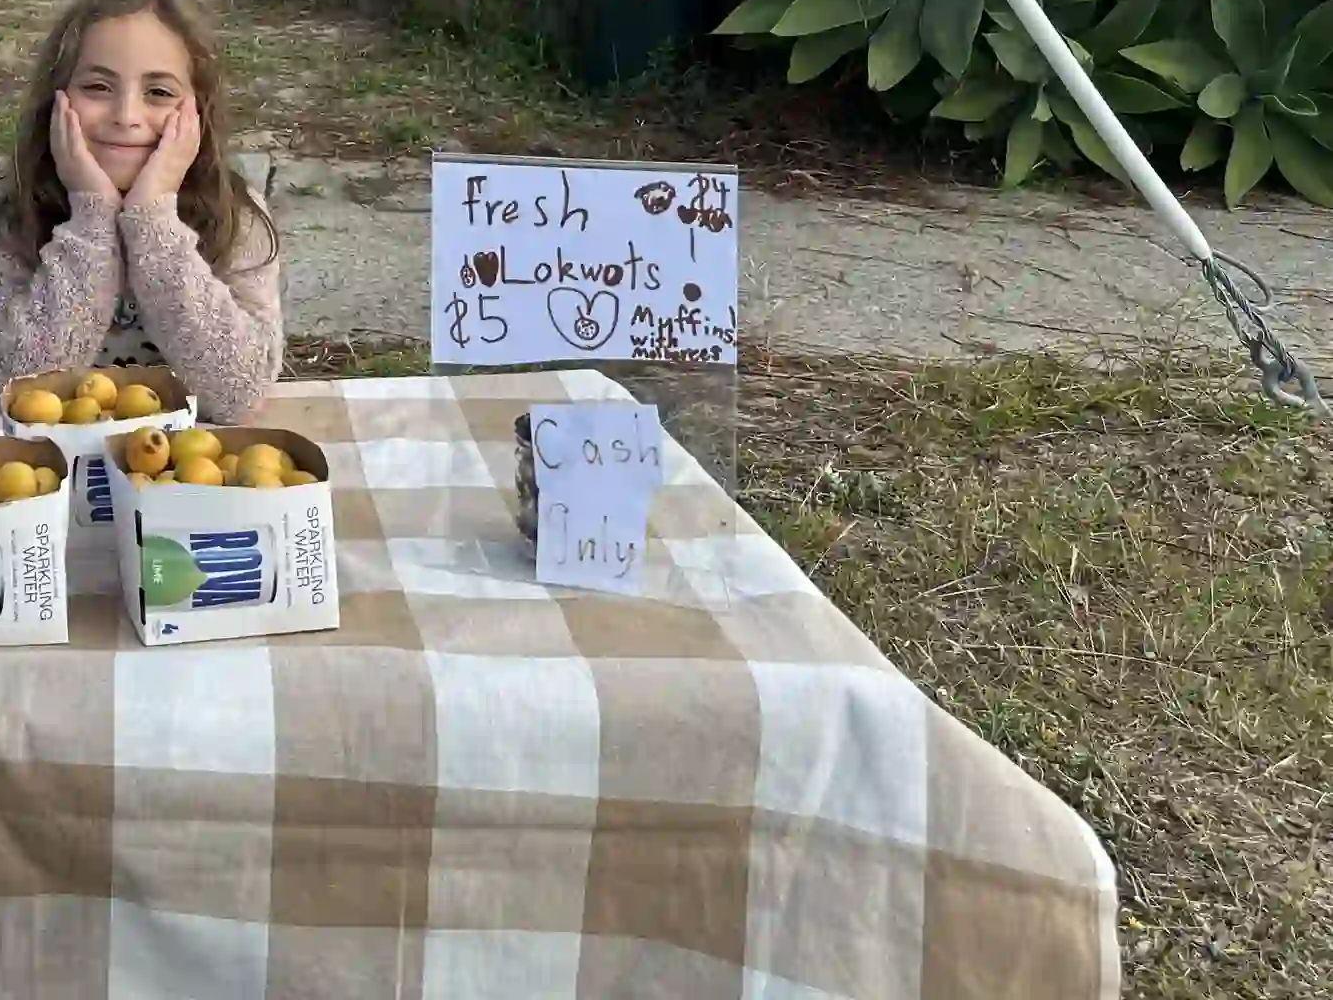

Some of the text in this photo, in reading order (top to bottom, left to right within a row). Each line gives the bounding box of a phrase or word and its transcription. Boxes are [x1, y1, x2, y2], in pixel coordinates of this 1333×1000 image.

[444, 292, 508, 348] $5
[534, 412, 659, 469] Cash
[22, 545, 38, 604] WATER
[35, 523, 53, 622] SPARKLING
[152, 558, 164, 585] LIME
[294, 528, 310, 589] WATER
[306, 505, 325, 606] SPARKLING
